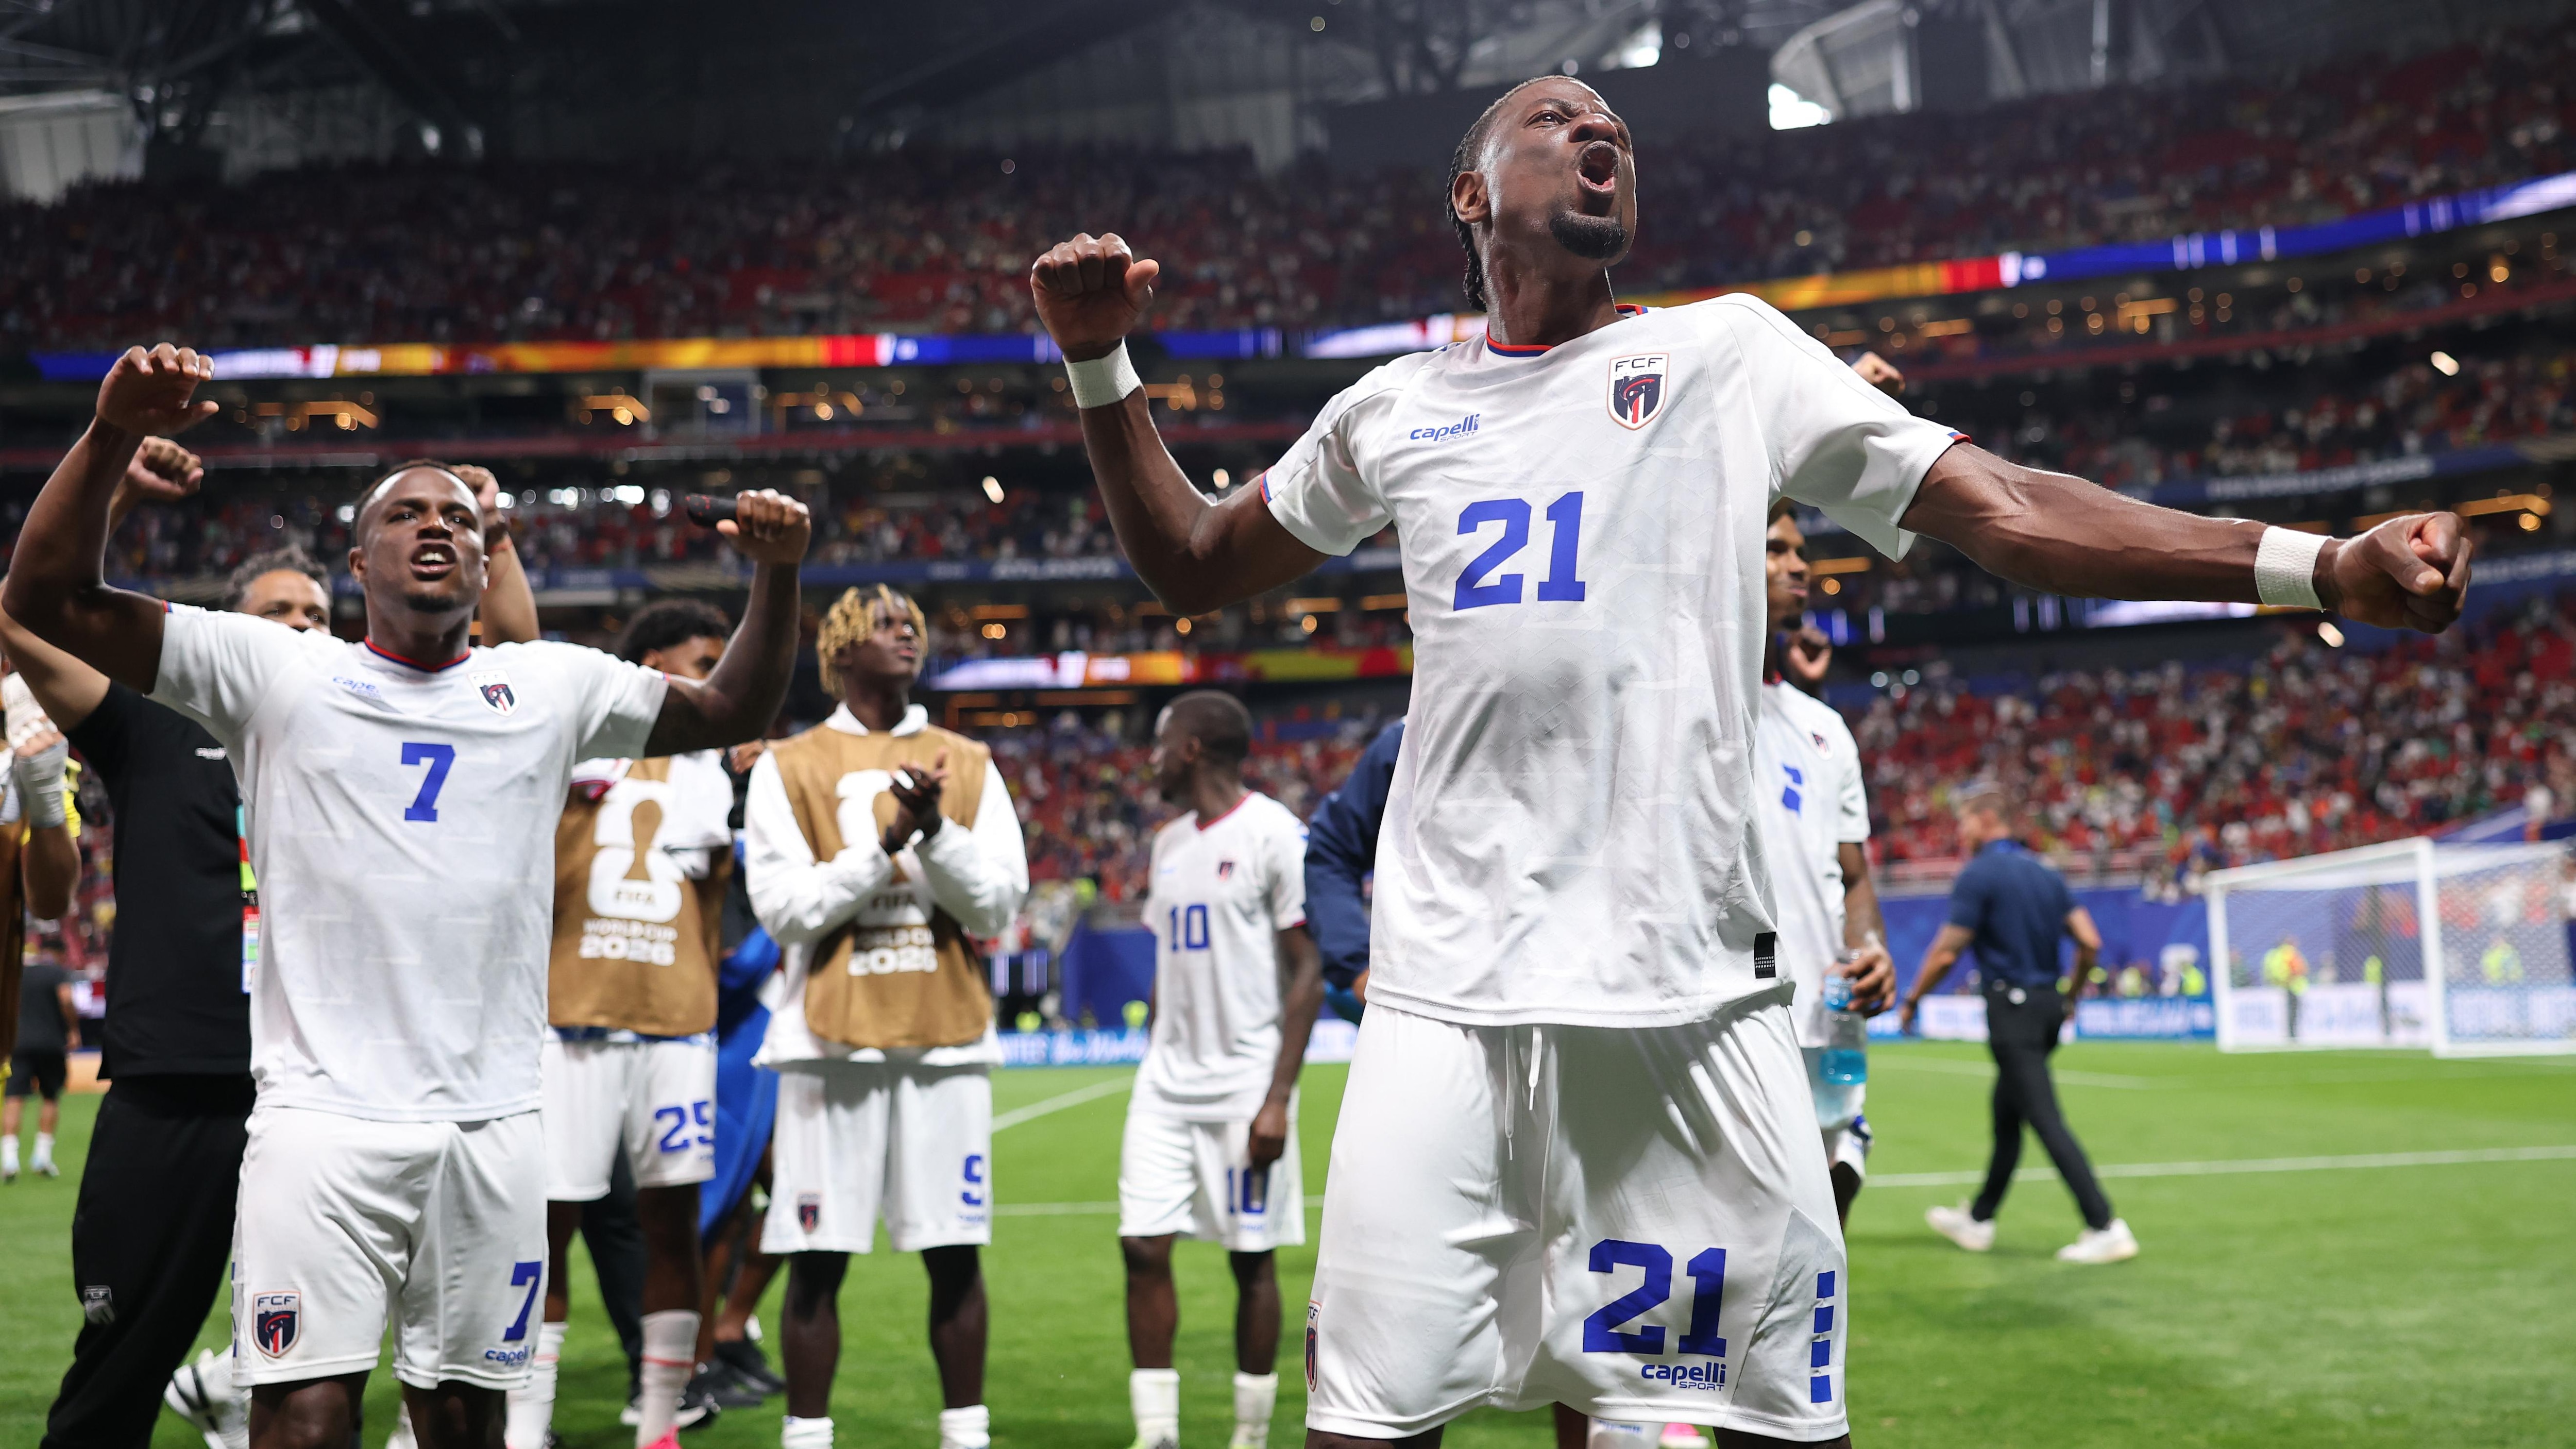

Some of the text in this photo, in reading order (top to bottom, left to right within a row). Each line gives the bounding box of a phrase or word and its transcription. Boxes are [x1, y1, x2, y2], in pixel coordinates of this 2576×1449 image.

[1615, 358, 1663, 372] FCF
[1410, 414, 1480, 442] capelli
[1439, 431, 1477, 442] SPORT
[1453, 491, 1585, 611] 21
[333, 676, 380, 693] cape
[401, 743, 455, 821] 7
[615, 890, 655, 904] FIFA
[583, 918, 679, 942] WORLD CUP
[1170, 905, 1209, 952] 10
[579, 933, 676, 967] 2026
[655, 1101, 715, 1153] 25
[1227, 1167, 1268, 1215] 10
[258, 1295, 296, 1307] FCF
[503, 1261, 543, 1342] 7
[1583, 1239, 1726, 1357] 21
[1641, 1362, 1726, 1386] capelli
[1679, 1381, 1725, 1392] SPORT
